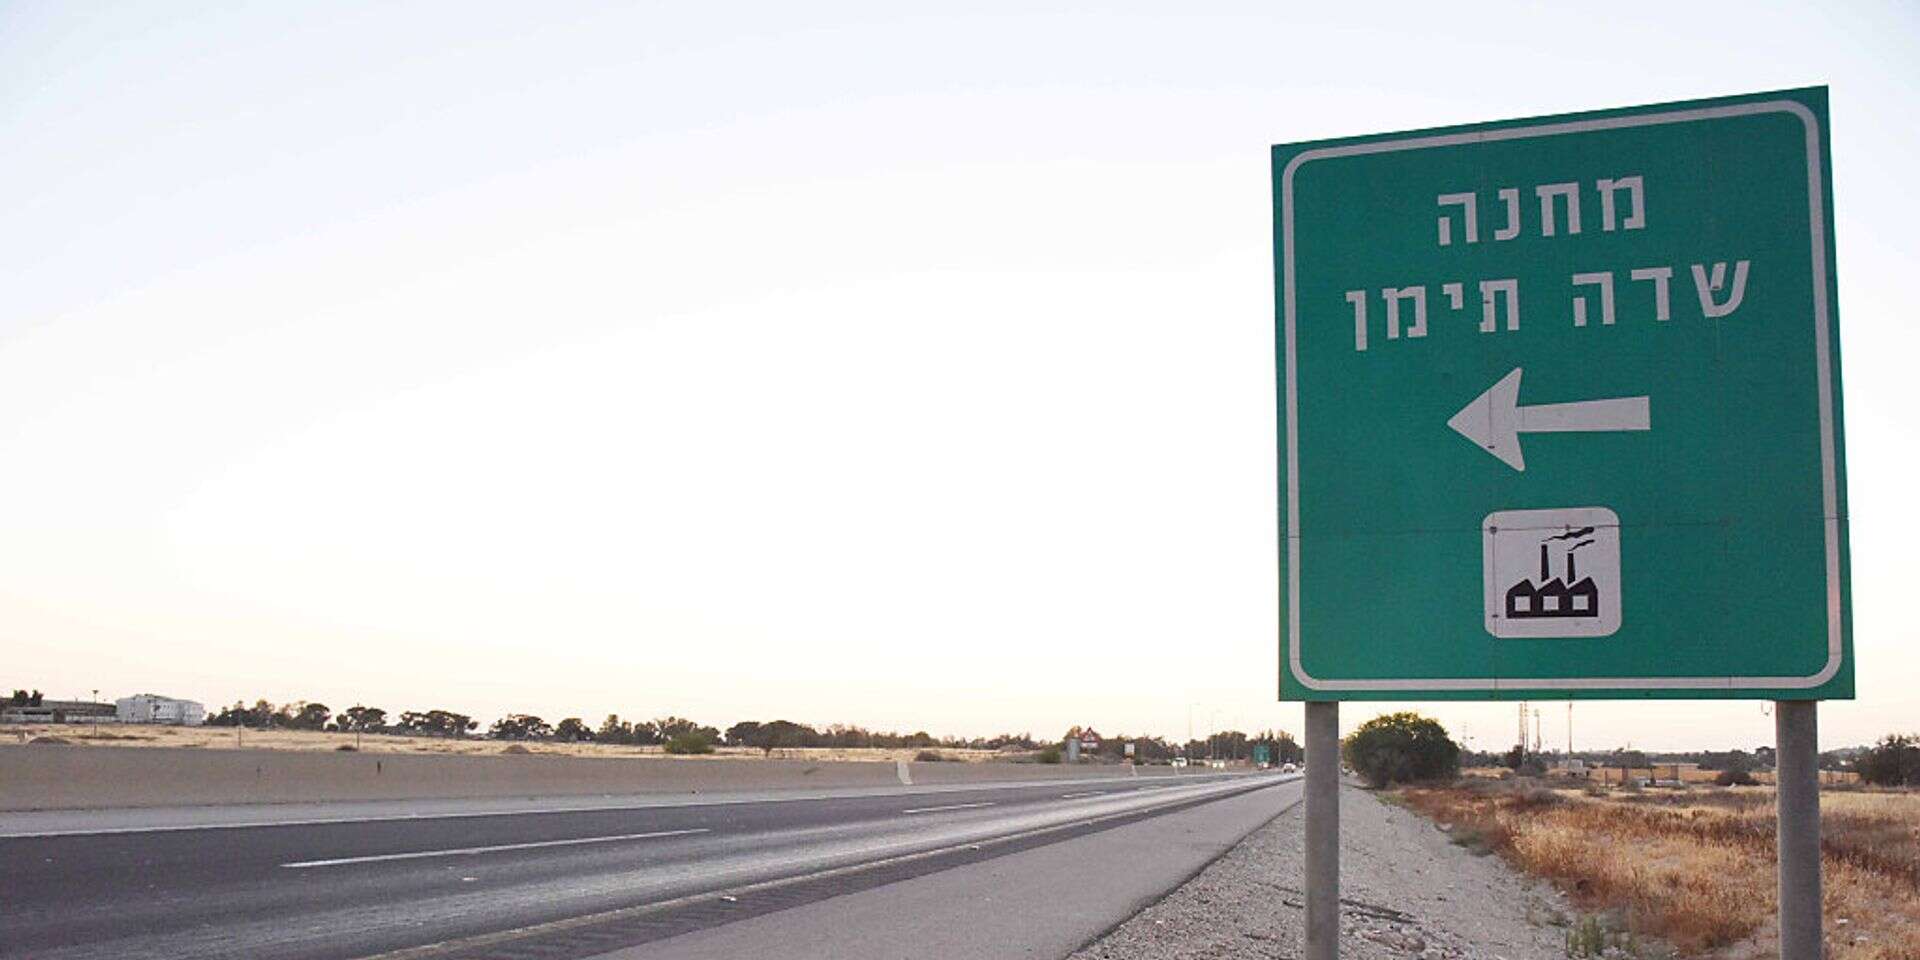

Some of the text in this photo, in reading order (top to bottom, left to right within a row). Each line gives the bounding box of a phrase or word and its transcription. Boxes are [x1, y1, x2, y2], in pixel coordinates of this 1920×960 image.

[1437, 176, 1646, 246] מחנה
[1345, 260, 1750, 352] שדה תימן
